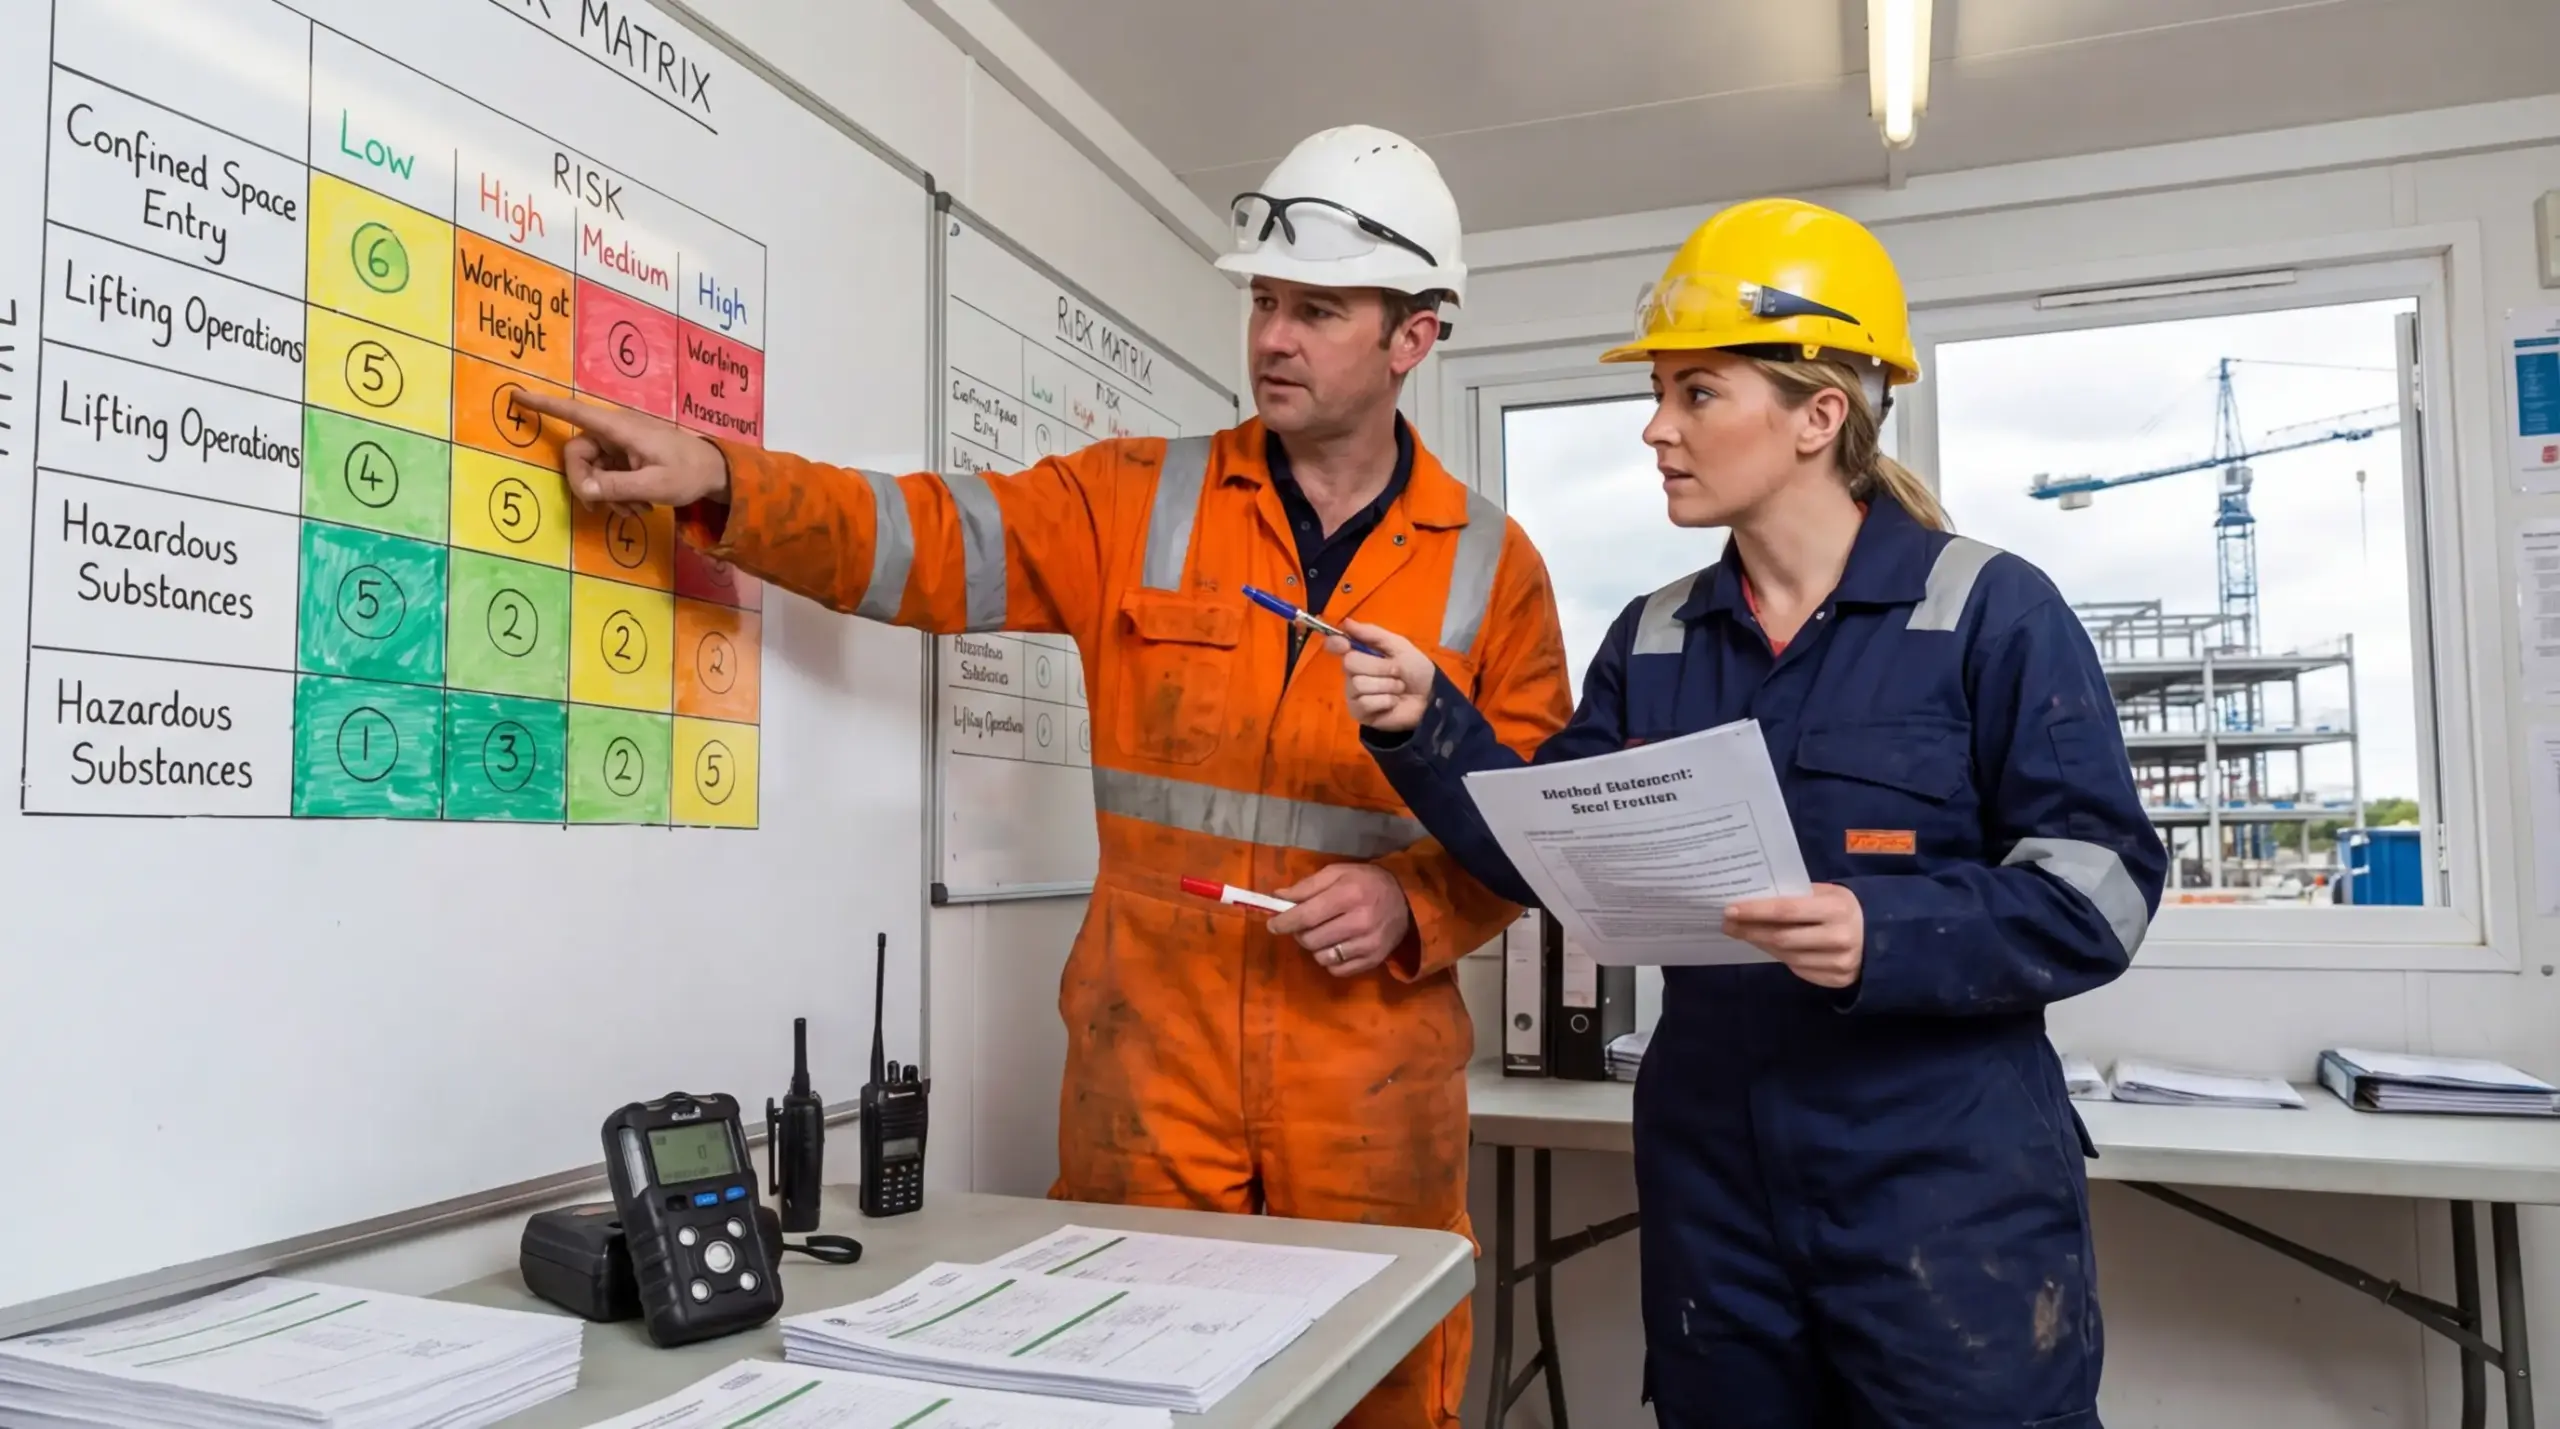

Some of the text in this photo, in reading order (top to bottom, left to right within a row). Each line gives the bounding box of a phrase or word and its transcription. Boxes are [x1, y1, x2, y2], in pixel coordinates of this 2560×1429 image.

[580, 0, 711, 113] MATRIX
[67, 103, 297, 222] Confined Space
[340, 108, 414, 180] Low
[481, 172, 544, 243] High
[554, 152, 624, 220] RISK
[143, 187, 227, 266] Entry
[368, 238, 390, 278] 6
[461, 248, 570, 321] Working at
[583, 223, 669, 291] Medium
[65, 258, 304, 363] Lifting Operations
[699, 272, 747, 330] High
[479, 301, 547, 360] Height
[619, 333, 636, 366] 6
[60, 379, 301, 469] Lifting Operations
[360, 453, 384, 492] 4
[64, 499, 238, 566] Hazardous
[501, 491, 523, 527] 5
[77, 561, 254, 620] Substances
[356, 579, 383, 620] 5
[502, 603, 523, 641] 2
[614, 625, 632, 661] 2
[58, 678, 232, 731] Hazardous
[71, 741, 253, 789] Substances
[496, 734, 519, 773] 3
[614, 748, 633, 781] 2
[704, 754, 723, 788] 5
